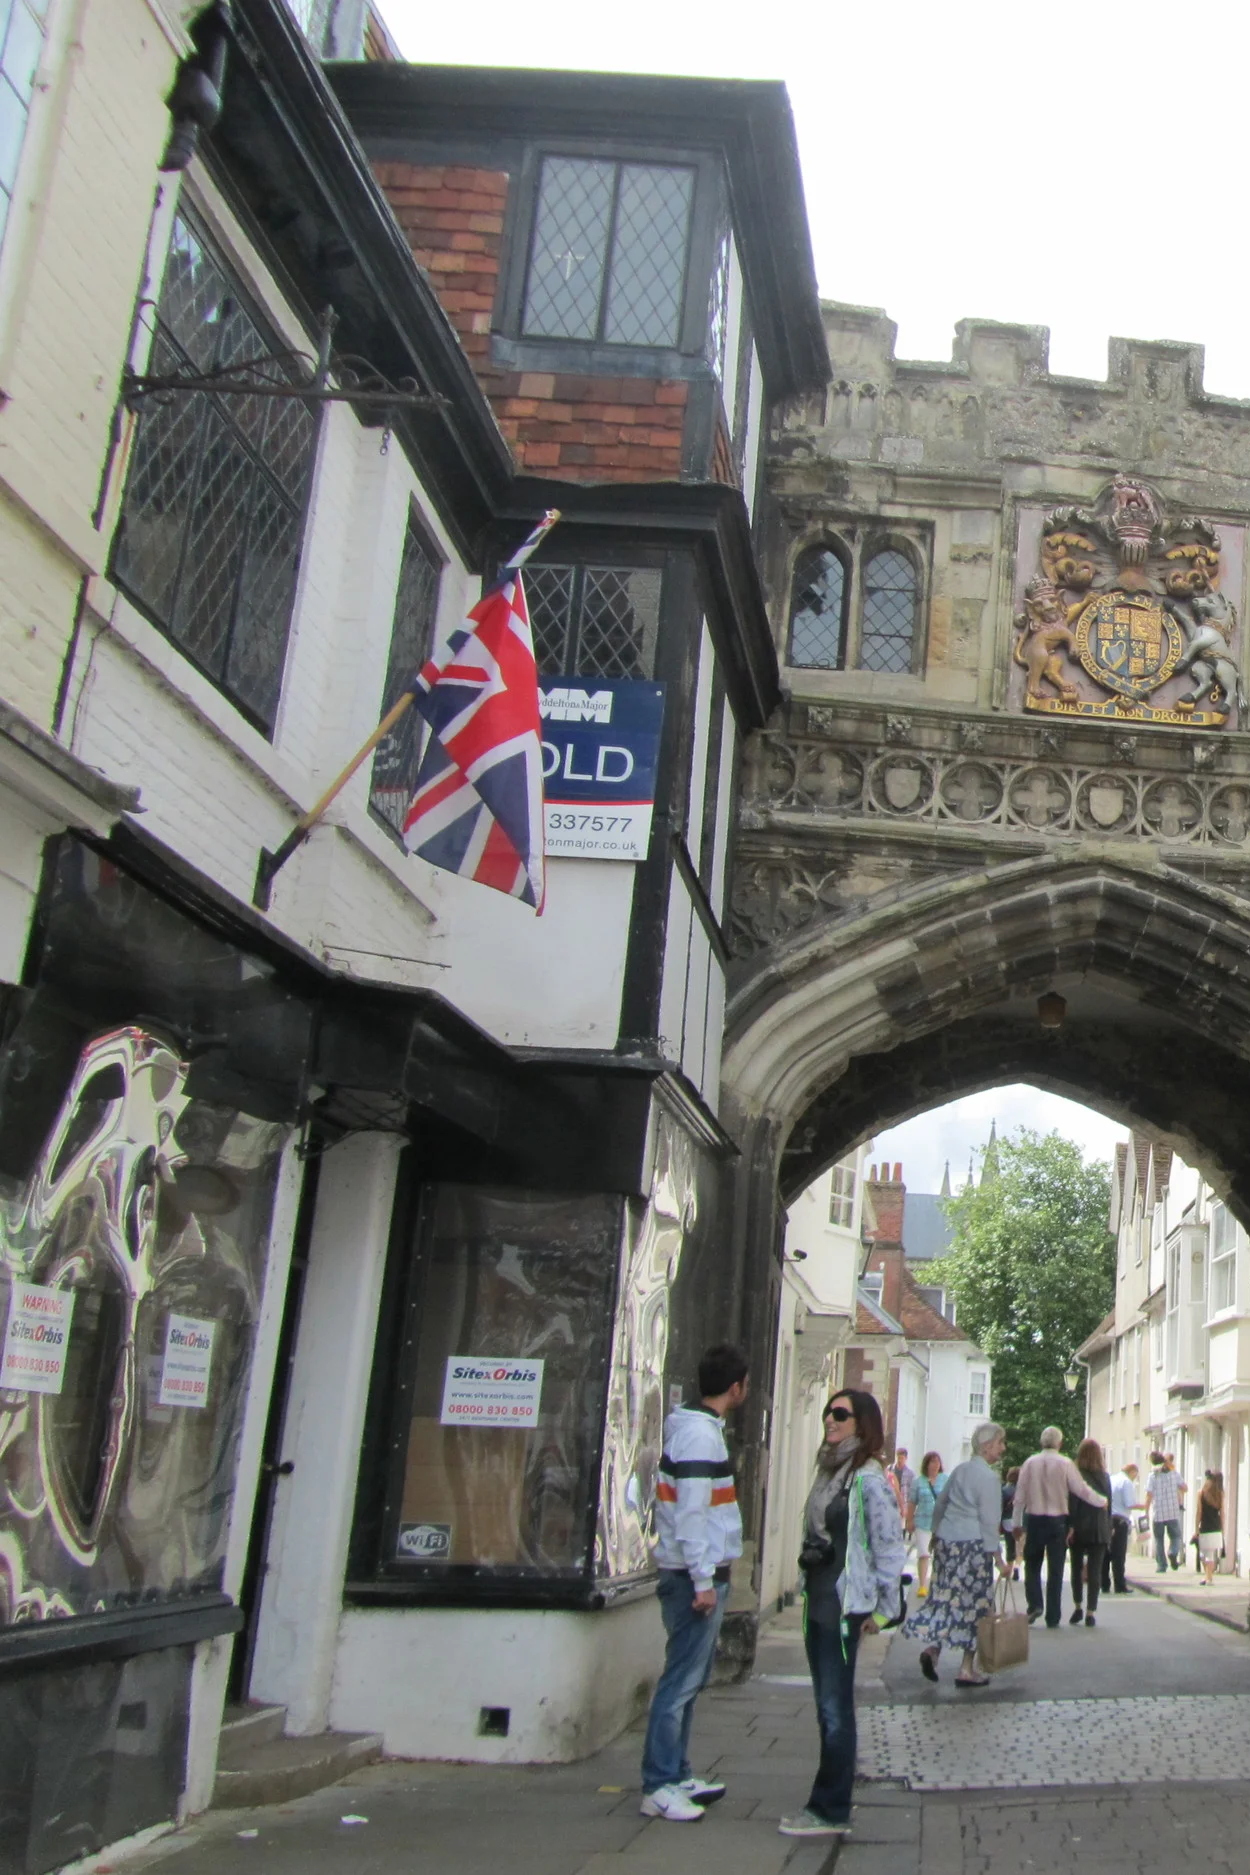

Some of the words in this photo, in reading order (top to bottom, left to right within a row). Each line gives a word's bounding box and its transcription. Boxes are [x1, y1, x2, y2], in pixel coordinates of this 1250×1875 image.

[1092, 704, 1108, 715] ET
[1115, 707, 1144, 718] MON
[1152, 711, 1193, 723] DROIT
[549, 813, 633, 833] 337577
[23, 1294, 63, 1315] WARNING
[11, 1321, 64, 1345] SitexOrbis
[170, 1329, 211, 1350] SitexOrbis
[453, 1367, 537, 1382] SitexOrbis
[448, 1404, 484, 1415] 08000
[487, 1405, 508, 1416] 830
[511, 1406, 533, 1417] 850
